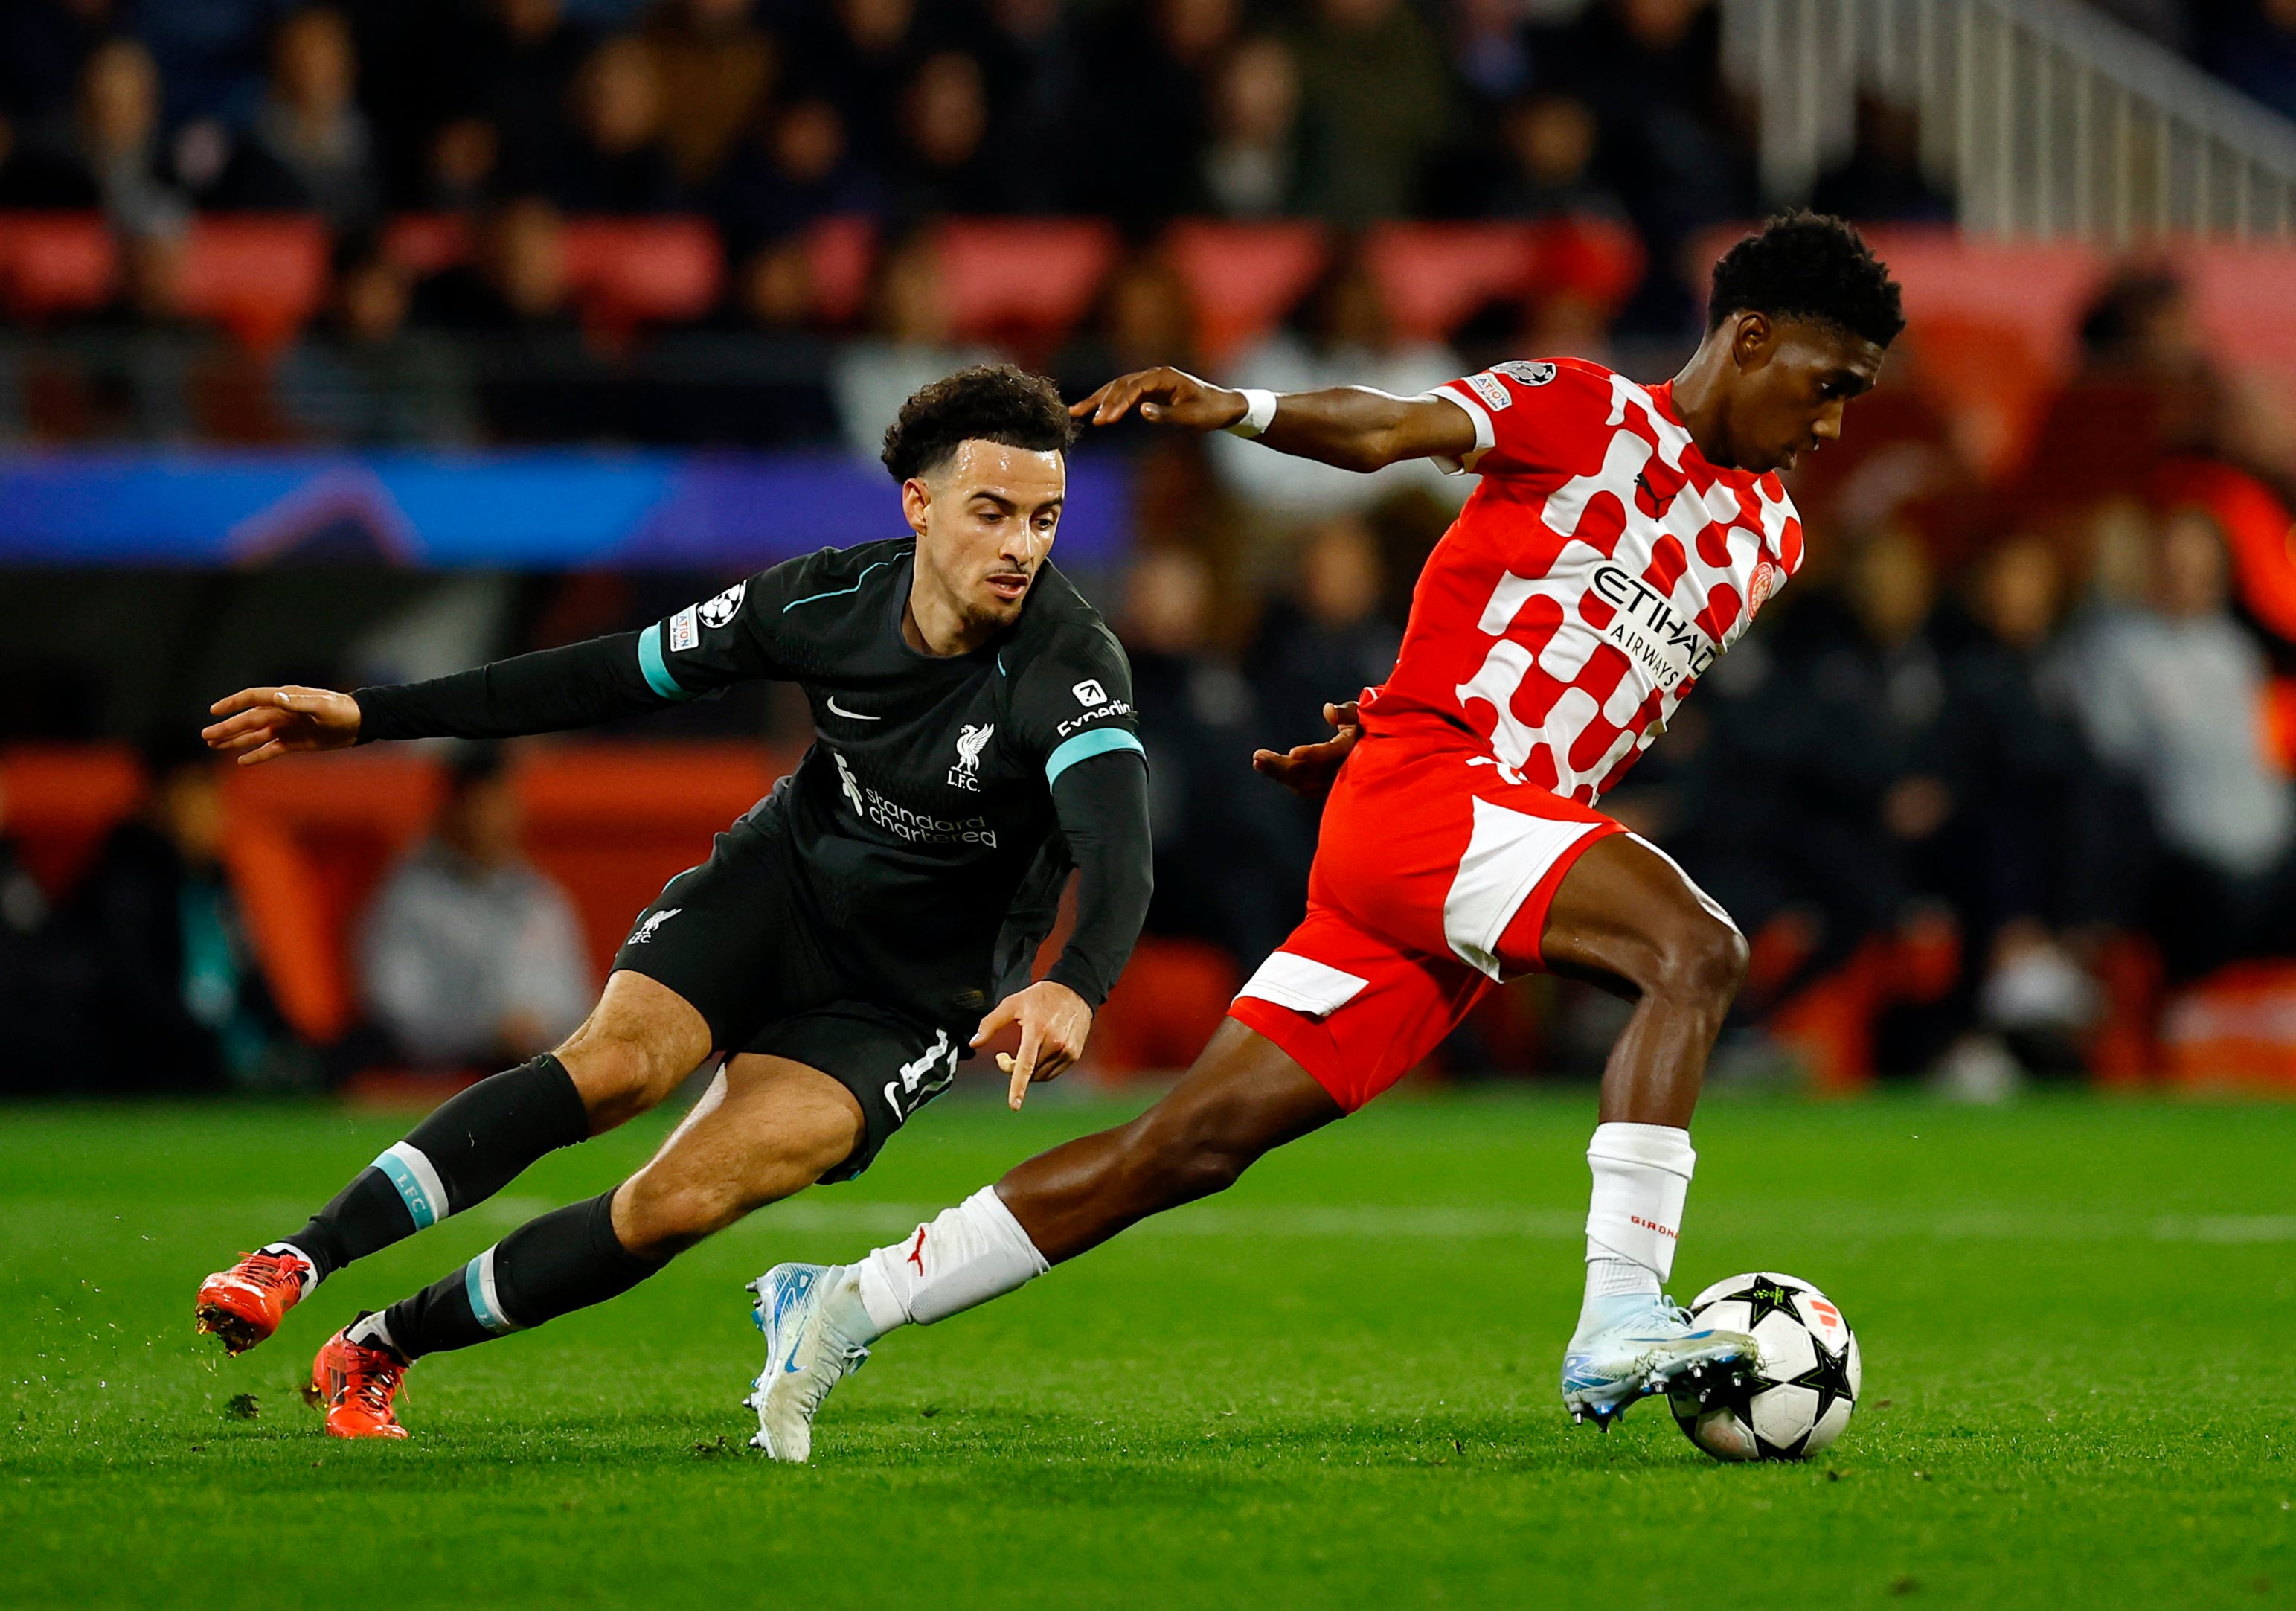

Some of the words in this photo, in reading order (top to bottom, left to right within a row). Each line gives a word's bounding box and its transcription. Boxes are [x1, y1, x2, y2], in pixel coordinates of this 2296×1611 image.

[1610, 624, 1679, 688] AIRWAYS
[865, 787, 986, 831] standard
[869, 806, 998, 849] chartered
